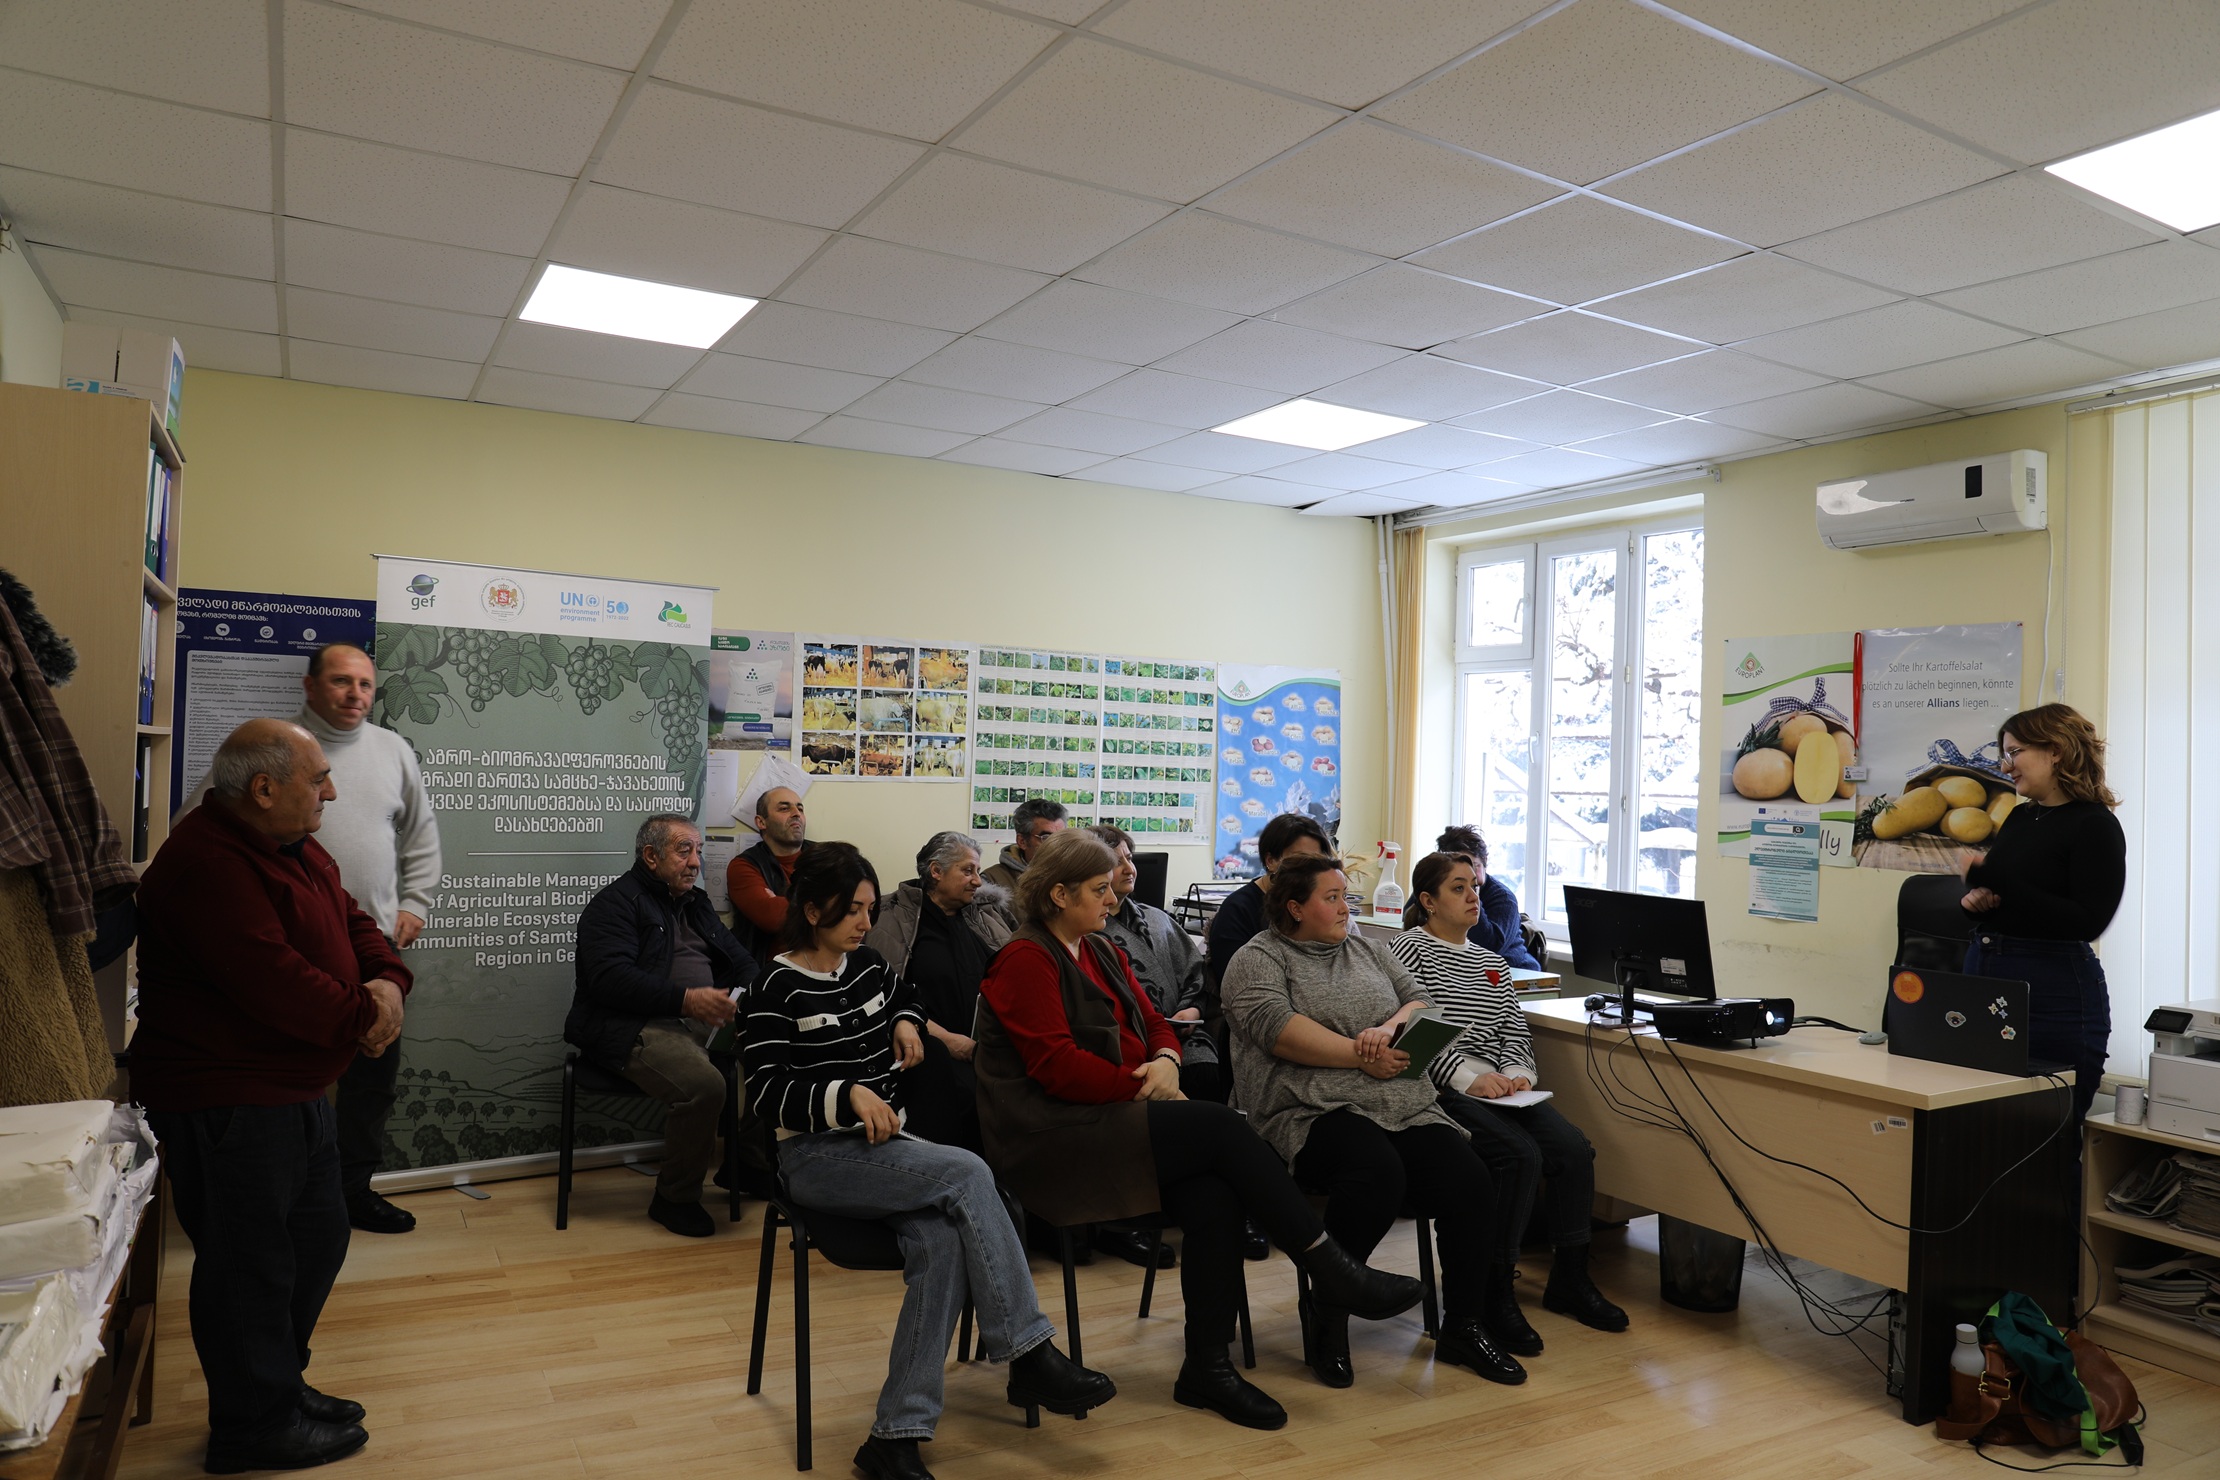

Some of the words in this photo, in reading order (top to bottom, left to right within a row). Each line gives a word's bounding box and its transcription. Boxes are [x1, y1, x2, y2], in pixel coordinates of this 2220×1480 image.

[177, 597, 229, 610] ველადი
[231, 601, 361, 618] მწარმოებლებისთვის
[411, 595, 436, 610] gef
[560, 592, 583, 606] UN
[177, 610, 201, 619] ოცესი,
[559, 614, 597, 622] programme
[560, 607, 600, 616] environment
[1735, 666, 1765, 679] EUROPLANT
[1889, 662, 1909, 672] Sollte
[1912, 662, 1923, 672] Ihr
[1926, 660, 1983, 672] Kartoffelsalat
[1862, 680, 1892, 693] plötzlich
[1906, 680, 1935, 690] lächeln
[1938, 679, 1980, 692] beginnen,
[1983, 678, 2014, 689] könnte
[1894, 700, 1924, 708] unserer
[1927, 698, 1960, 708] Allians
[1962, 698, 1989, 710] liegen
[426, 748, 666, 770] აგრო-ბიომრავალფეროვნების
[422, 771, 473, 788] გრადი
[477, 772, 540, 789] მართვა
[544, 774, 685, 791] სამცხე-ჯავახეთის
[427, 794, 473, 810] ყვლად
[477, 794, 602, 811] ეკოსისტემებსა
[605, 796, 622, 811] და
[626, 796, 692, 812] სასოფლო
[494, 816, 603, 833] დასახლებებში
[1820, 829, 1841, 856] lly
[441, 872, 541, 889] Sustainable
[446, 891, 546, 912] Agricultural
[402, 932, 504, 949] mmunities
[508, 930, 525, 945] of
[475, 950, 532, 969] Region
[536, 949, 551, 963] in
[556, 948, 576, 963] Ge
